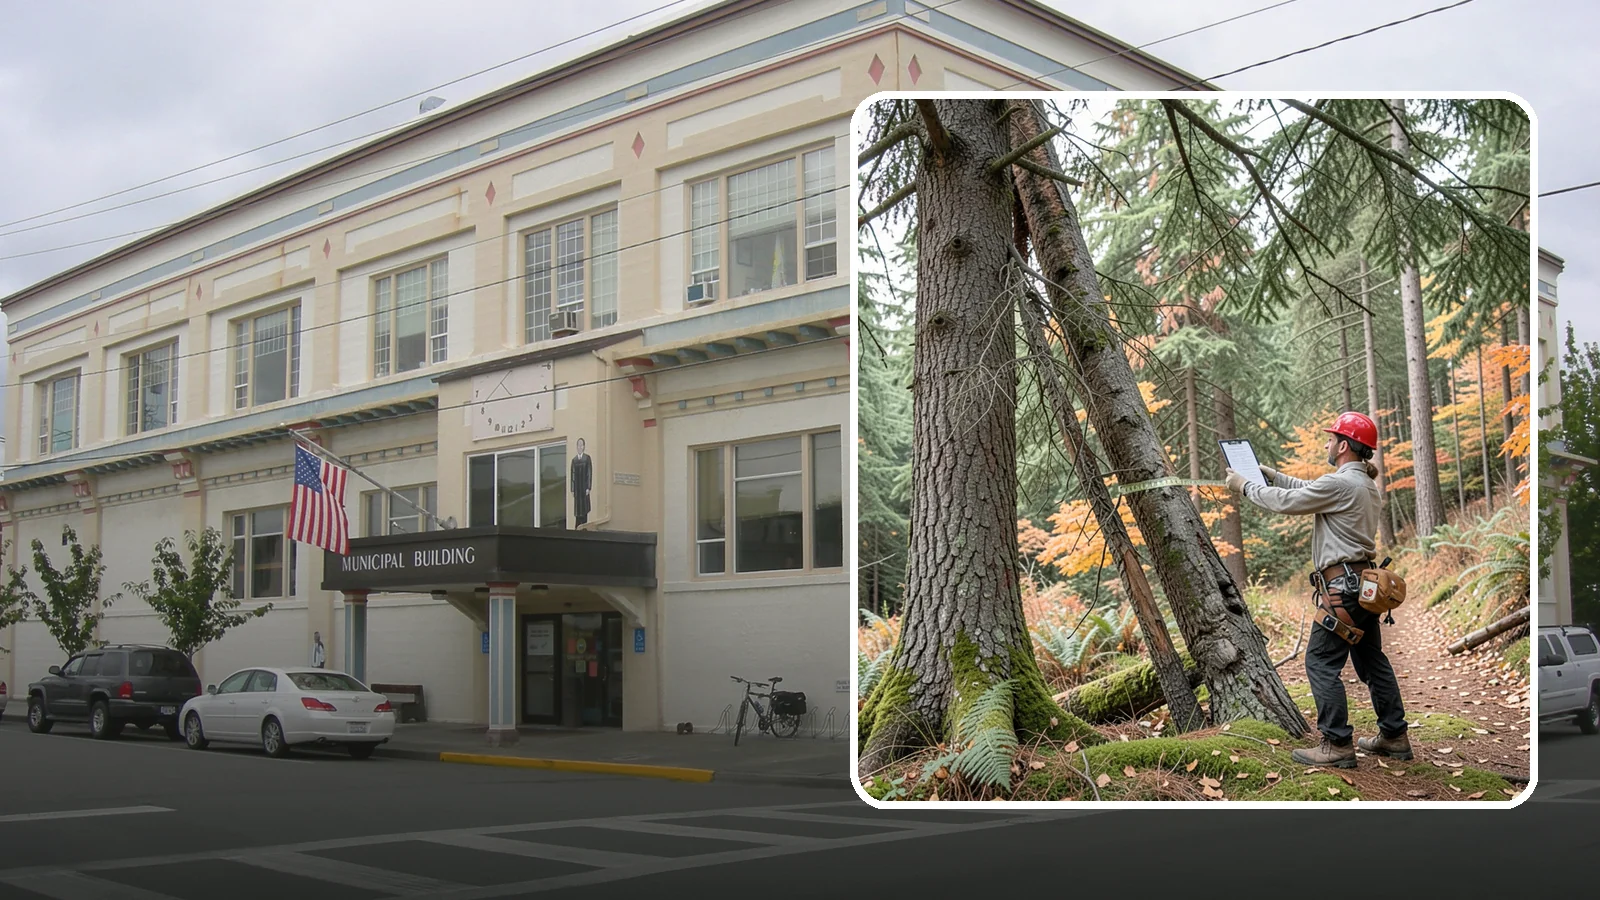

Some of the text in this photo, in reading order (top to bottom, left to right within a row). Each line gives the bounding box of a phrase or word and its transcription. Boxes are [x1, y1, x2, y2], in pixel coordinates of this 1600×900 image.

[475, 390, 479, 398] 7
[481, 407, 485, 415] 8
[487, 417, 492, 426] 9
[494, 423, 500, 431] 10
[501, 425, 506, 433] 11
[507, 425, 513, 433] 12
[521, 420, 525, 428] 2
[528, 413, 533, 422] 3
[536, 402, 540, 410] 4
[342, 546, 475, 572] MUNICIPAL BUILDING
